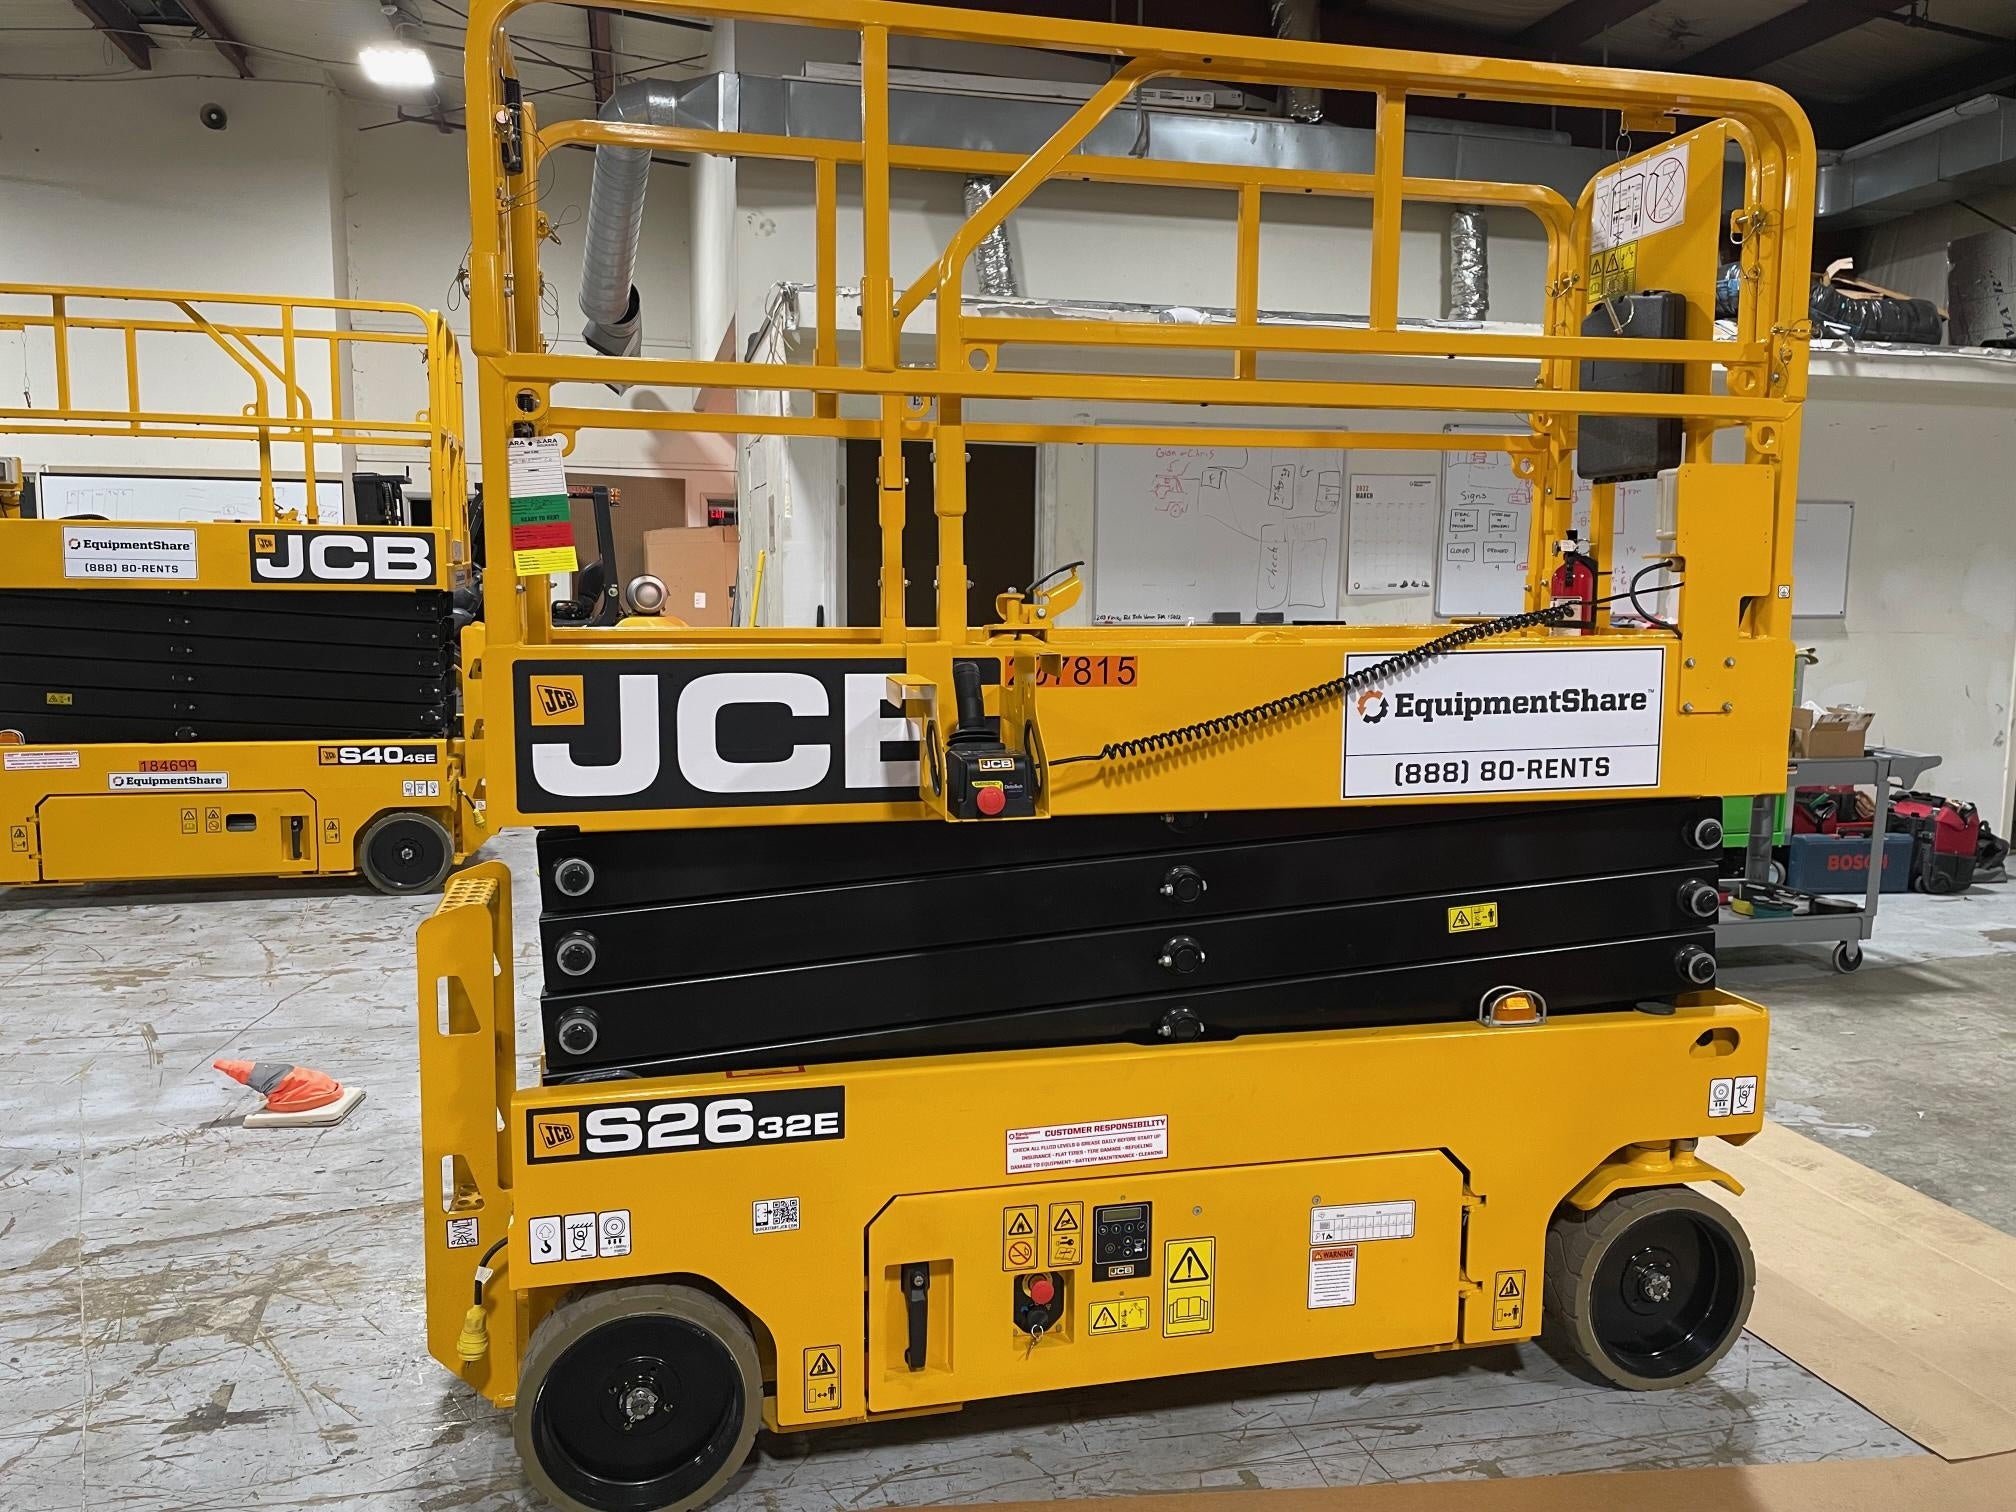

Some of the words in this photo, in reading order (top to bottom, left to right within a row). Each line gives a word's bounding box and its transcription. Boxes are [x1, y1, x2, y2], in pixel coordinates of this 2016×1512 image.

[1461, 491, 1486, 503] Signs
[711, 510, 724, 518] EXIT
[256, 535, 431, 579] JCB
[85, 563, 117, 573] (888)
[121, 564, 179, 574] 80-RENTS
[544, 688, 576, 714] JCB
[1394, 688, 1647, 722] EquipmentShare
[141, 760, 197, 772] 184699
[982, 759, 1012, 768] JCB
[1395, 760, 1469, 786] (888)
[1480, 757, 1610, 781] 80-RENTS
[1045, 1126, 1092, 1137] CUSTOMER
[1094, 1119, 1165, 1132] RESPONSIBILITY
[546, 1124, 572, 1146] JCB
[1013, 1145, 1030, 1153] CHECK
[1022, 1153, 1051, 1161] INSURANCE
[1041, 1159, 1071, 1167] EQUIPMENT
[1075, 1156, 1097, 1164] BATTERY
[1098, 1153, 1134, 1161] MAINTENANCE
[1138, 1150, 1163, 1158] CLEANING
[1323, 1249, 1353, 1259] WARNING
[1111, 1267, 1132, 1275] JCB
